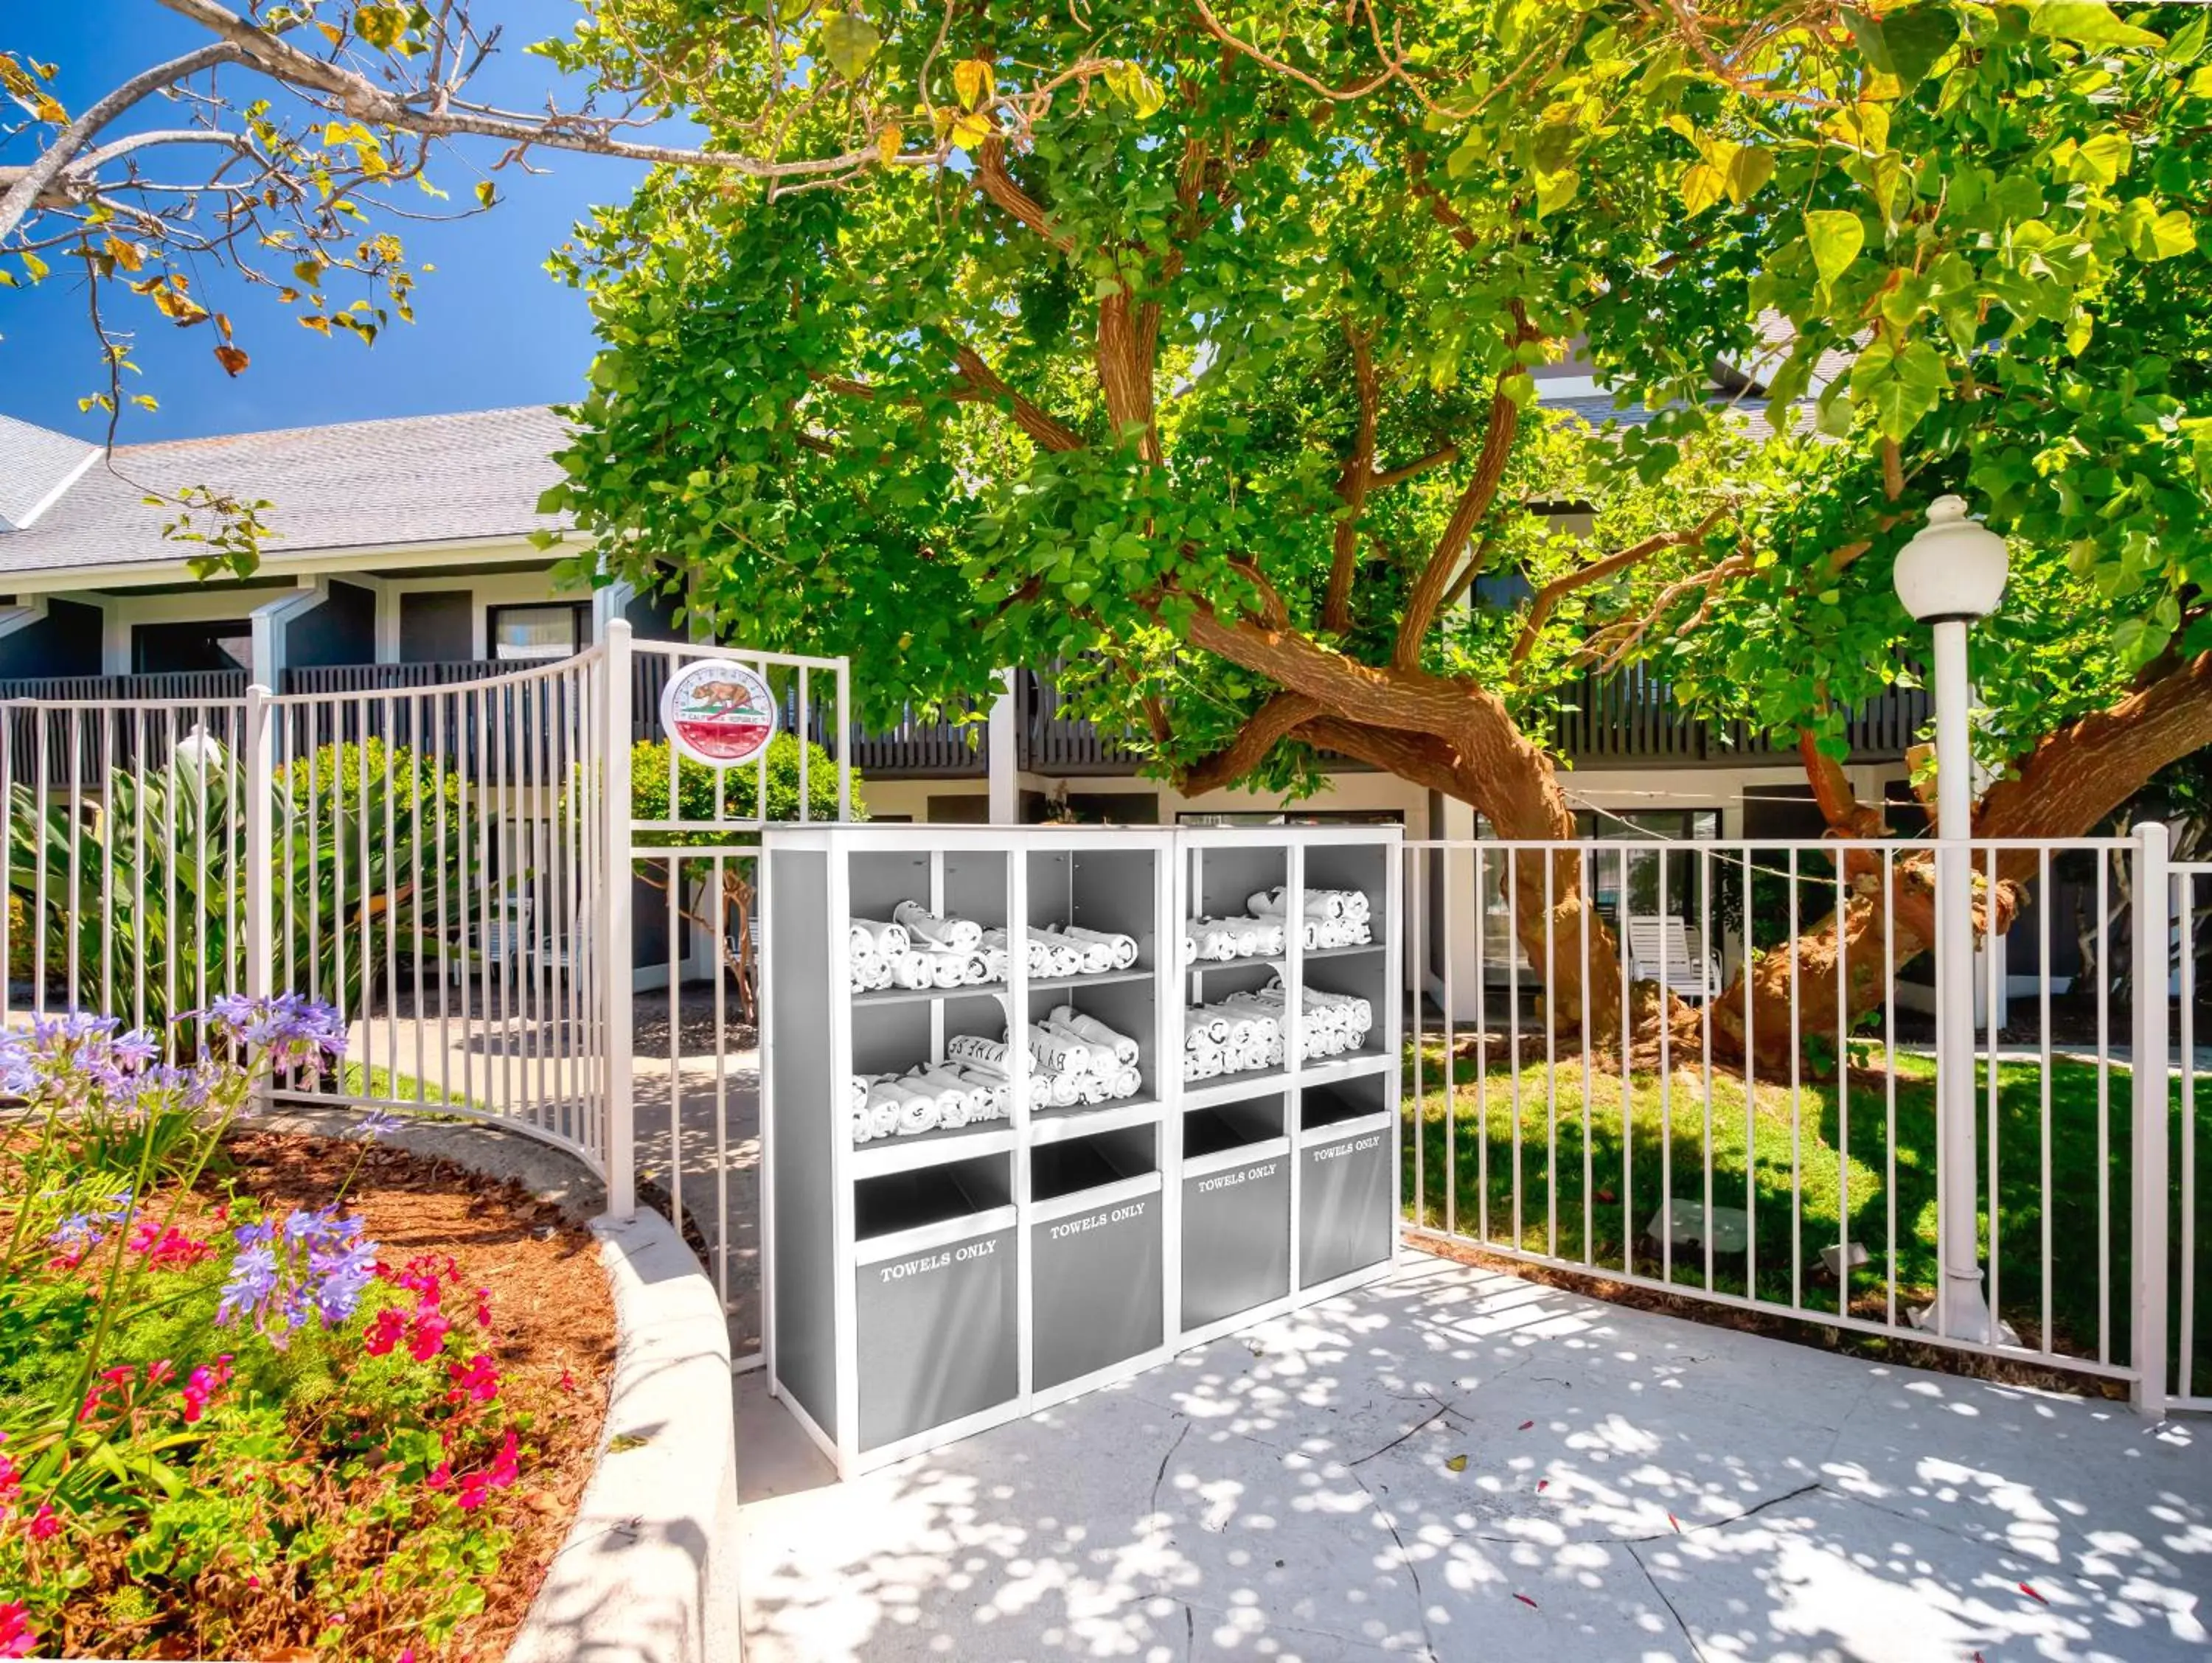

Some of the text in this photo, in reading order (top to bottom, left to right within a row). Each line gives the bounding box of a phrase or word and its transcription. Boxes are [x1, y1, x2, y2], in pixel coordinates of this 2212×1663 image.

[1313, 1136, 1380, 1162] TOWELS ONLY
[1198, 1163, 1277, 1193] TOWELS ONLY
[1050, 1202, 1145, 1239] TOWELS ONLY
[880, 1239, 997, 1283] TOWELS ONLY
